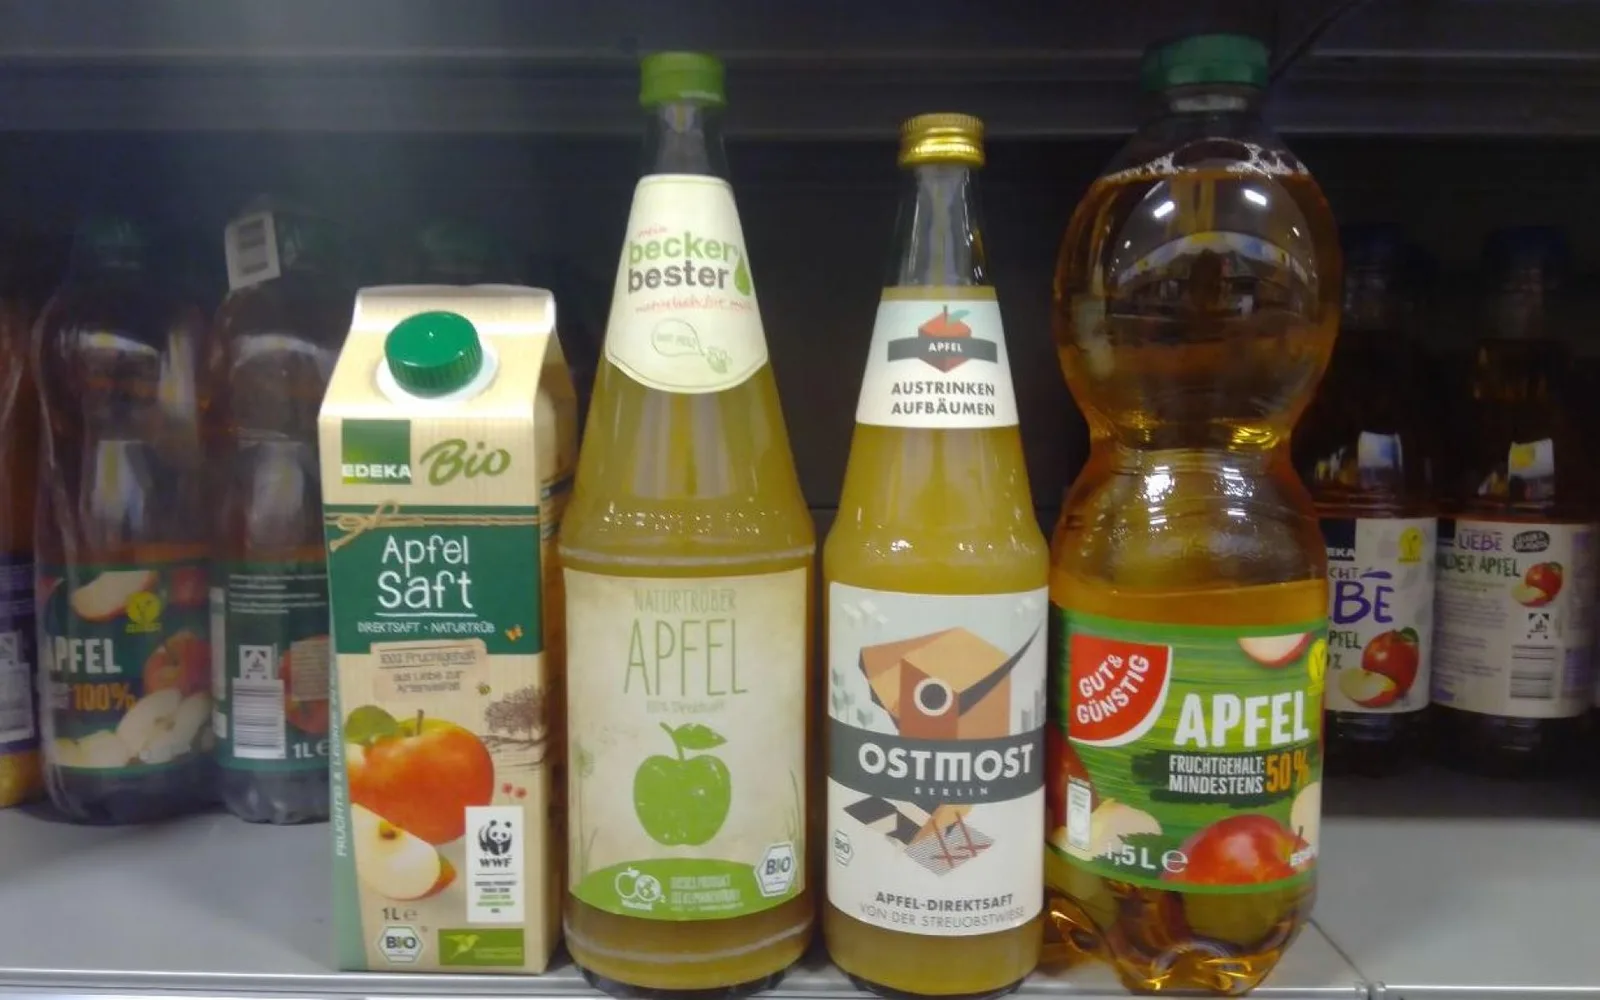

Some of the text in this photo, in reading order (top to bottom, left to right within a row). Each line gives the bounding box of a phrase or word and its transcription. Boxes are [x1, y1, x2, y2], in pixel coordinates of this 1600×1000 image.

[628, 260, 729, 295] bester
[928, 342, 963, 353] APFEL
[891, 381, 995, 396] AUSTRINKEN
[891, 398, 995, 415] AUFBÄUMEN
[341, 439, 511, 486] EDEKA Bio
[381, 534, 469, 577] Apfel
[378, 570, 473, 608] Saft
[358, 621, 420, 633] DIREKTSAFT
[624, 618, 748, 696] APFEL
[1076, 654, 1149, 724] GÜNSTIG
[1174, 691, 1309, 746] APFEL
[858, 742, 1033, 782] OSTMOST
[1169, 754, 1265, 775] FRUCHTGEHALT:
[914, 786, 988, 796] BERLIN
[1169, 774, 1264, 794] MINDESTENS
[479, 857, 513, 868] WWF
[766, 857, 791, 876] BIO
[876, 891, 1014, 912] APFEL-DIREKTSAFT
[859, 902, 887, 918] VON
[892, 911, 916, 926] DER
[385, 936, 416, 949] BIO
